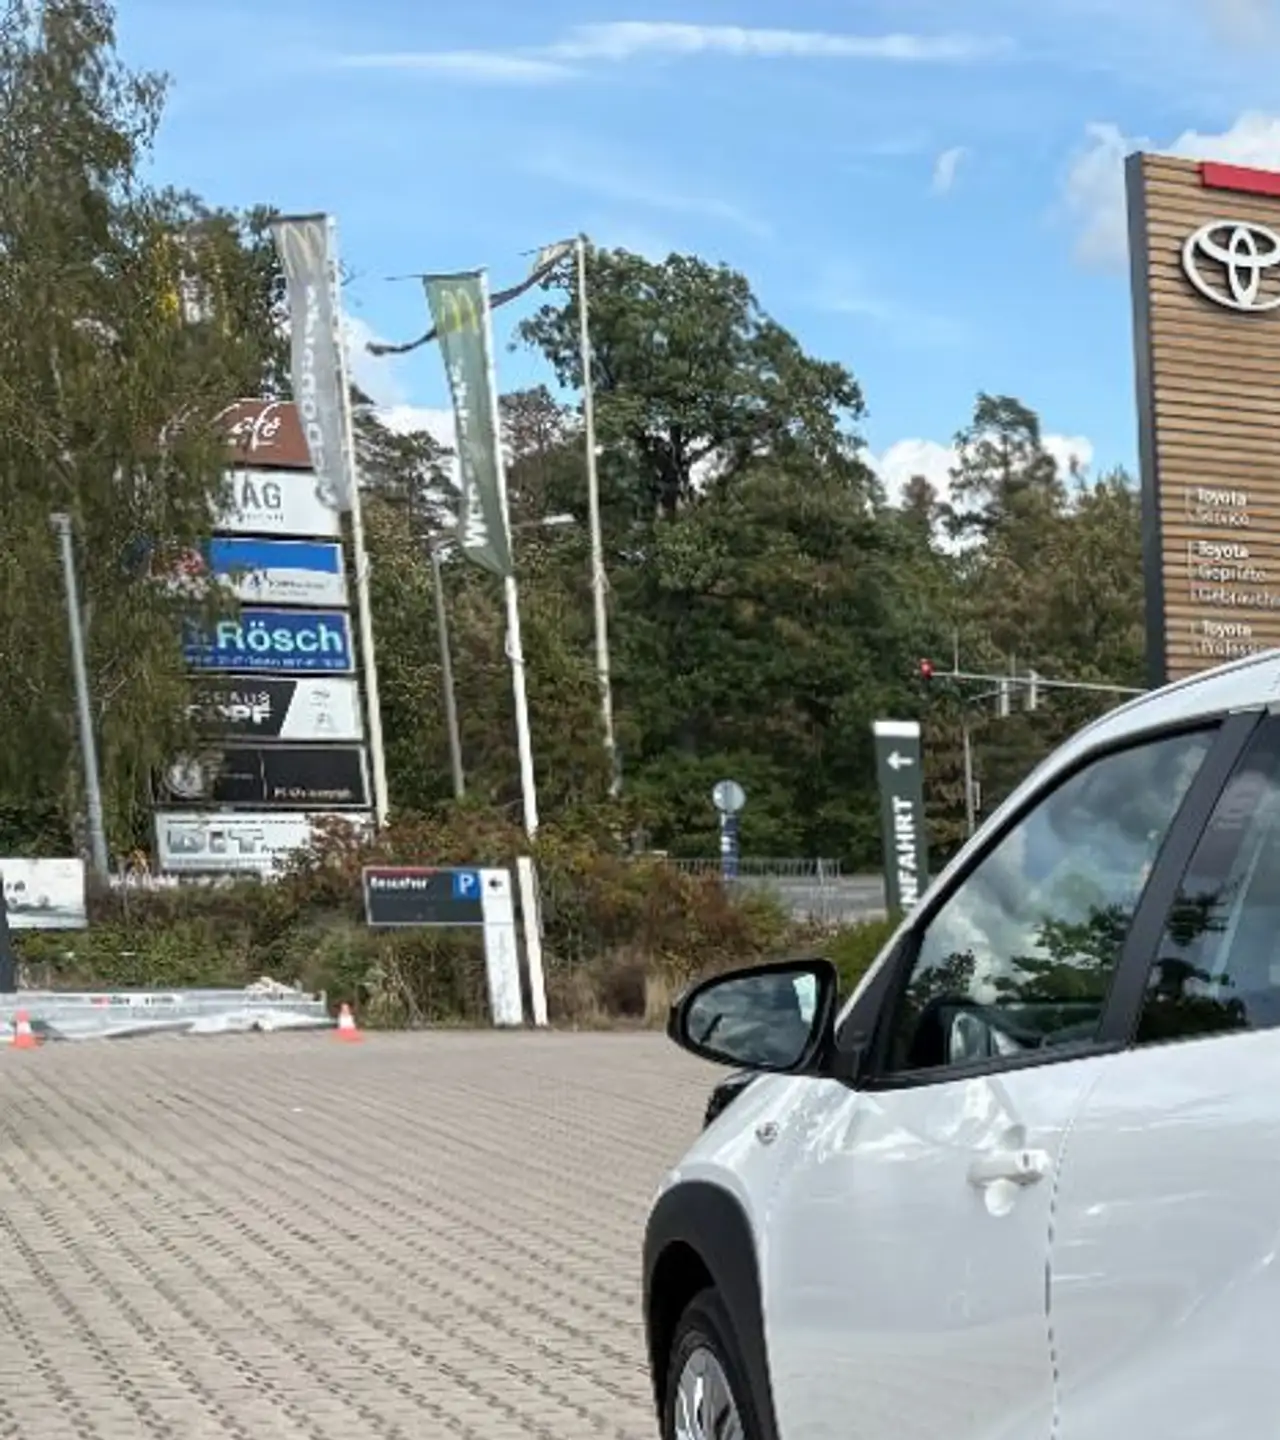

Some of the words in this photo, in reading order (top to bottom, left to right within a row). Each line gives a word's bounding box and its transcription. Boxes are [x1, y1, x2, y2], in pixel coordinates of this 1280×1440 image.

[1197, 488, 1248, 507] Toyota
[1198, 540, 1250, 560] Toyota
[216, 620, 344, 653] Rösch
[1202, 620, 1253, 639] Toyota
[459, 873, 474, 895] P
